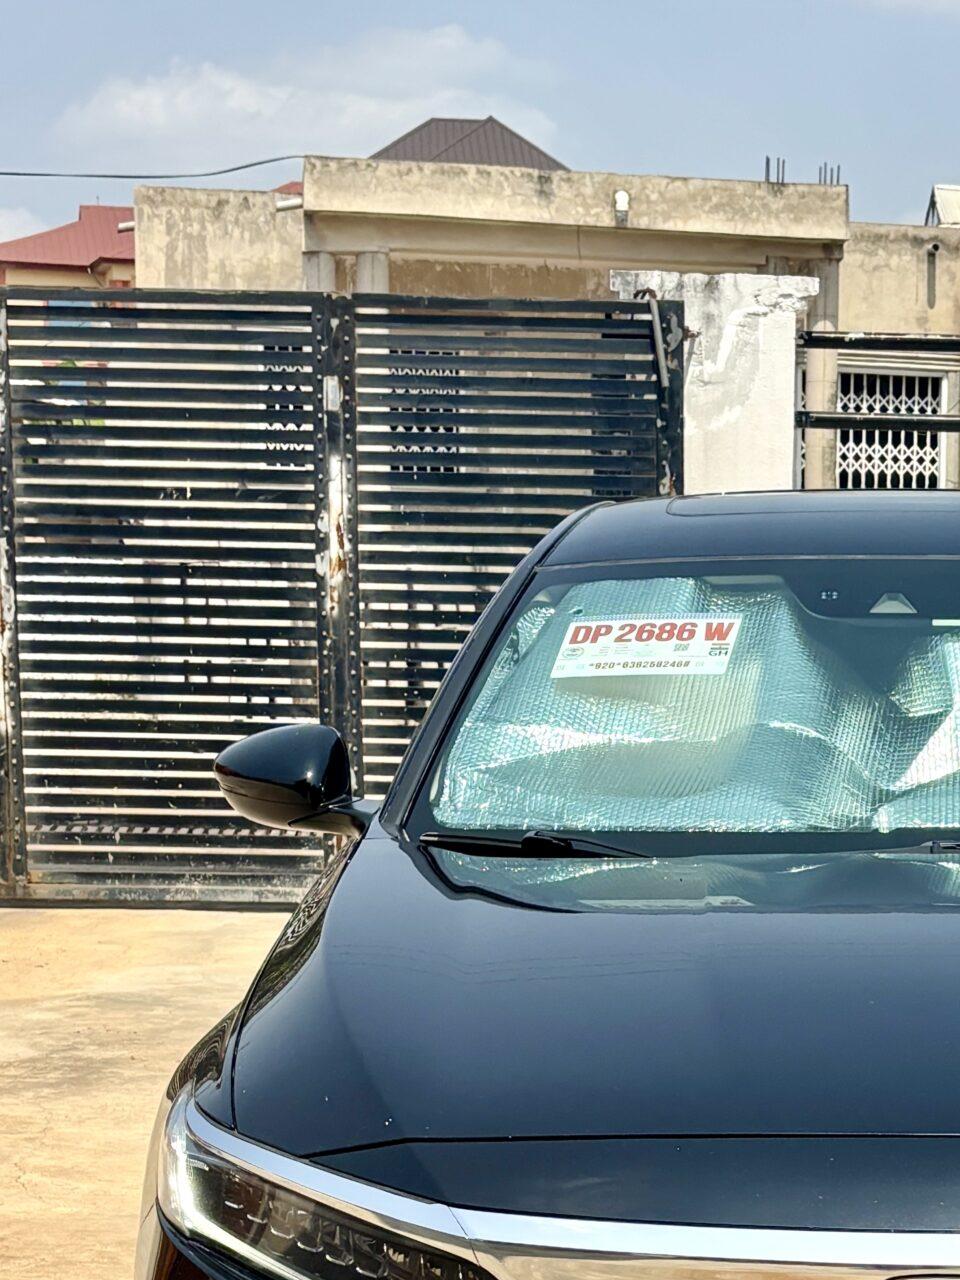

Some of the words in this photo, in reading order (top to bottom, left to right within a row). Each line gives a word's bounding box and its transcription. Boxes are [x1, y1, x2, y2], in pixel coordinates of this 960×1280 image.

[569, 625, 613, 644] DP
[614, 623, 698, 642] 2686
[704, 622, 735, 641] W
